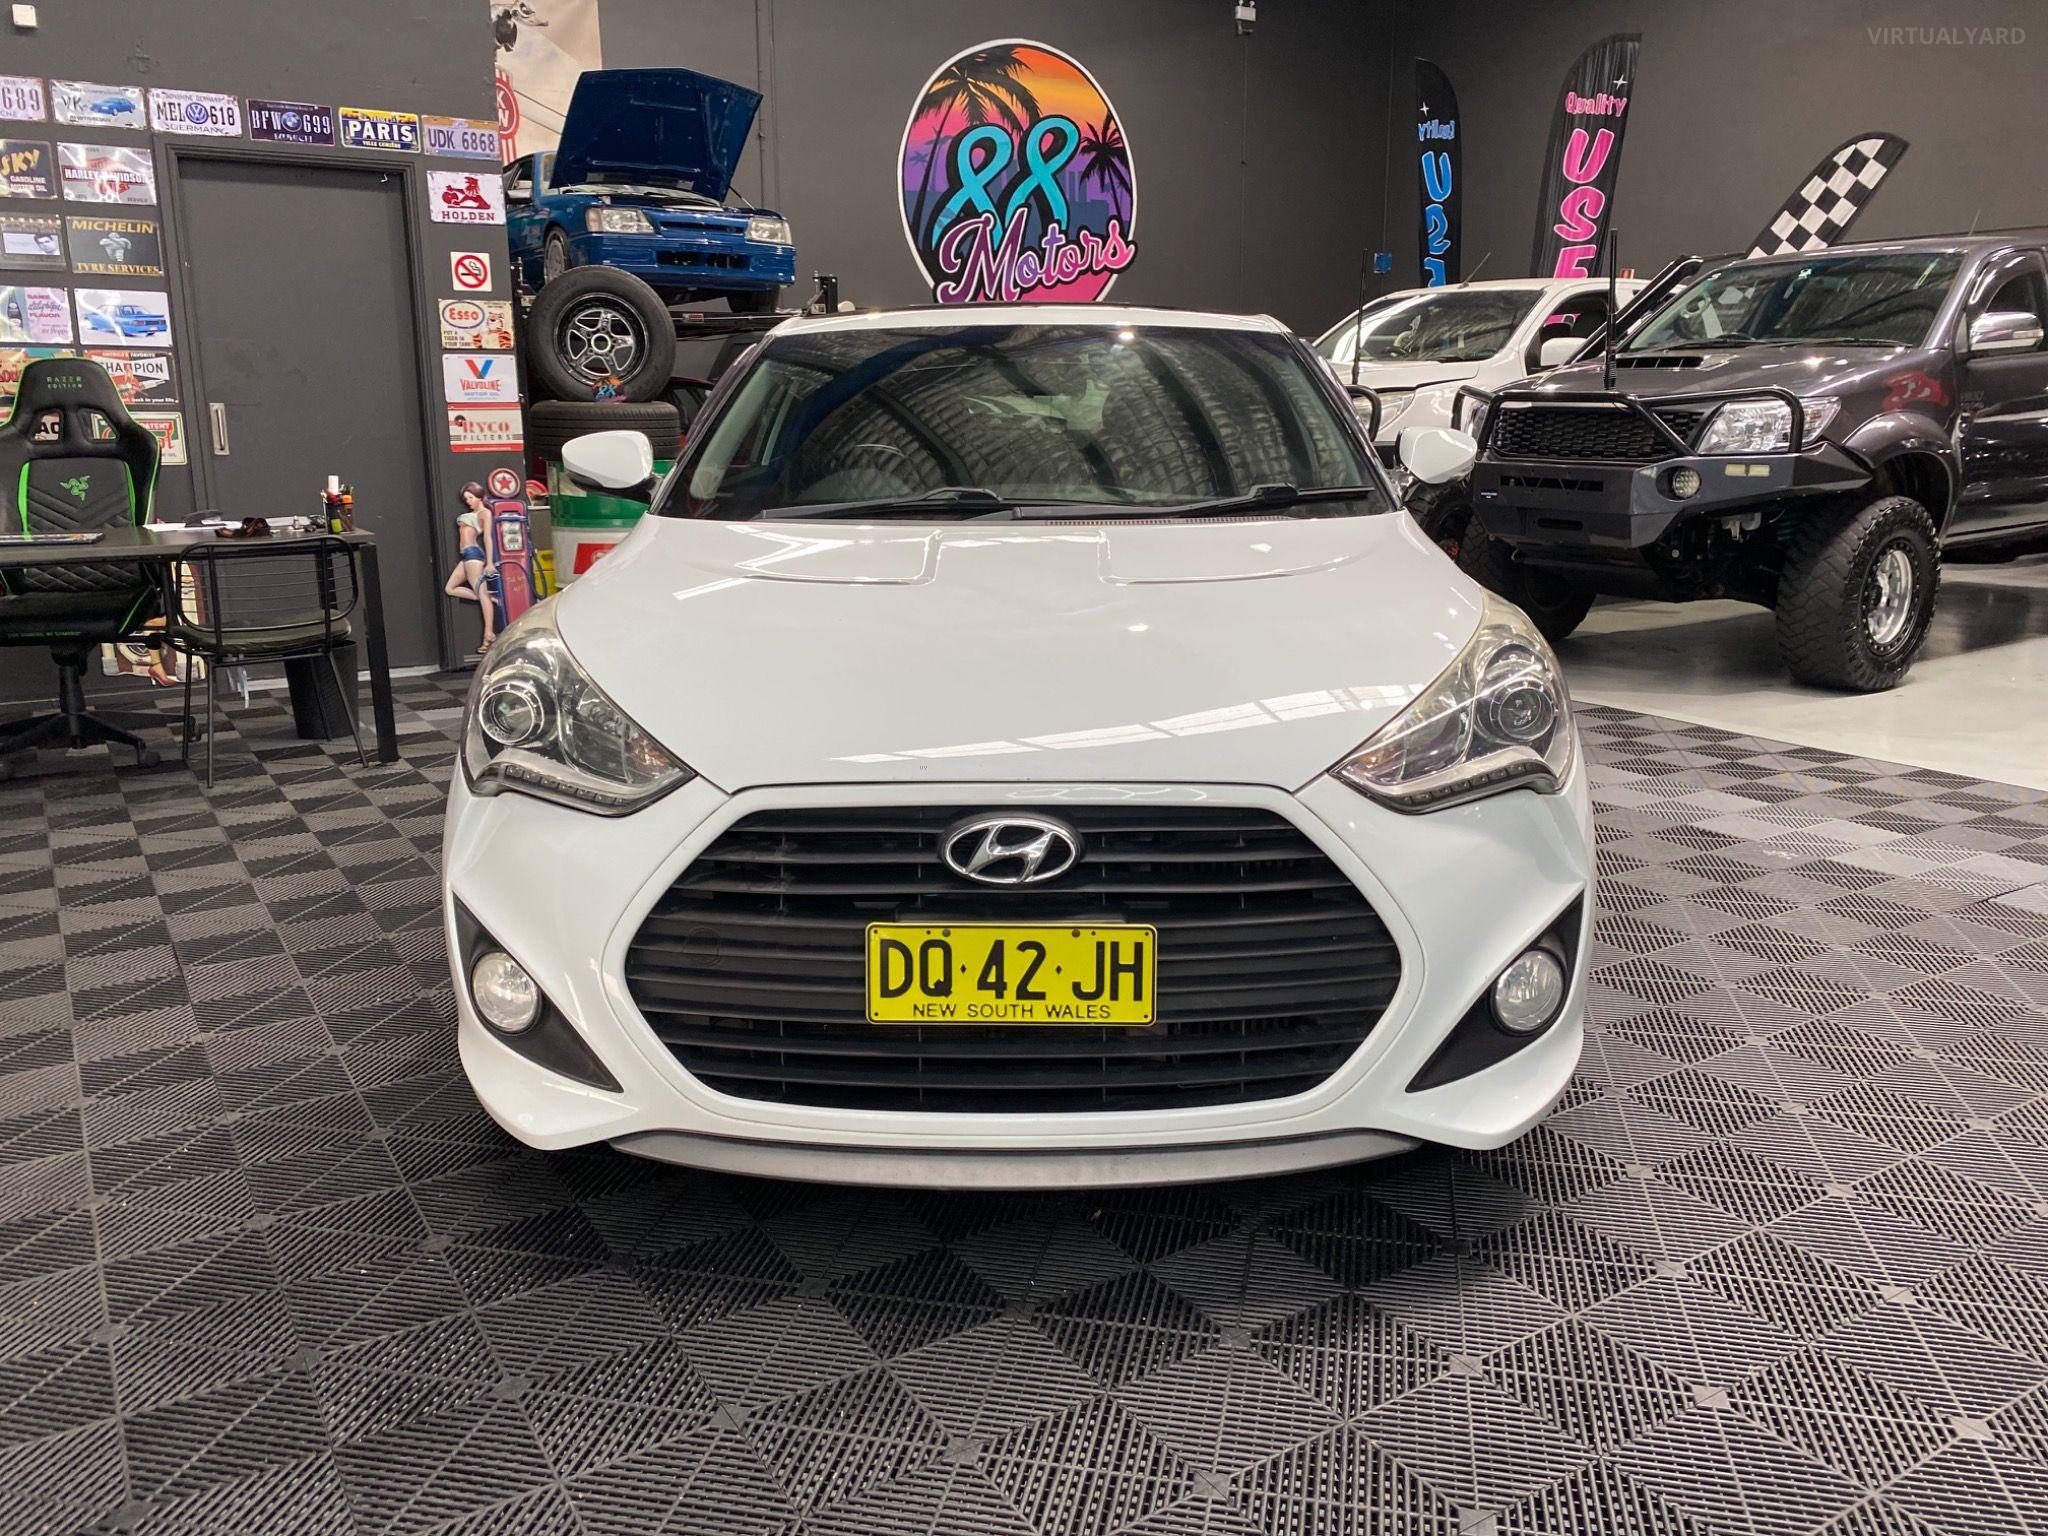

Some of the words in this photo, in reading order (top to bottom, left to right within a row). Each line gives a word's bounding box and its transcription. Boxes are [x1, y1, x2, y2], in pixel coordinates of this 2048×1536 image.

[2, 87, 40, 112] 689
[1565, 91, 1628, 118] Quality
[156, 103, 186, 122] MEL
[210, 106, 235, 126] 618
[303, 114, 331, 134] 699
[348, 120, 413, 142] PARIS
[428, 129, 455, 150] UDK
[461, 132, 496, 152] 6868
[0, 148, 41, 176] SKY
[932, 115, 1081, 250] 88
[72, 220, 154, 234] MICHELIN
[441, 210, 495, 222] HOLDEN
[937, 207, 1136, 303] Motors
[77, 262, 106, 272] TYRE
[108, 264, 160, 274] SERVICES
[460, 379, 501, 392] VALVOLINE
[462, 421, 510, 434] RYCO
[913, 1003, 957, 1018] NEW
[967, 1003, 1033, 1019] SOUTH
[1045, 1004, 1111, 1019] WALES
